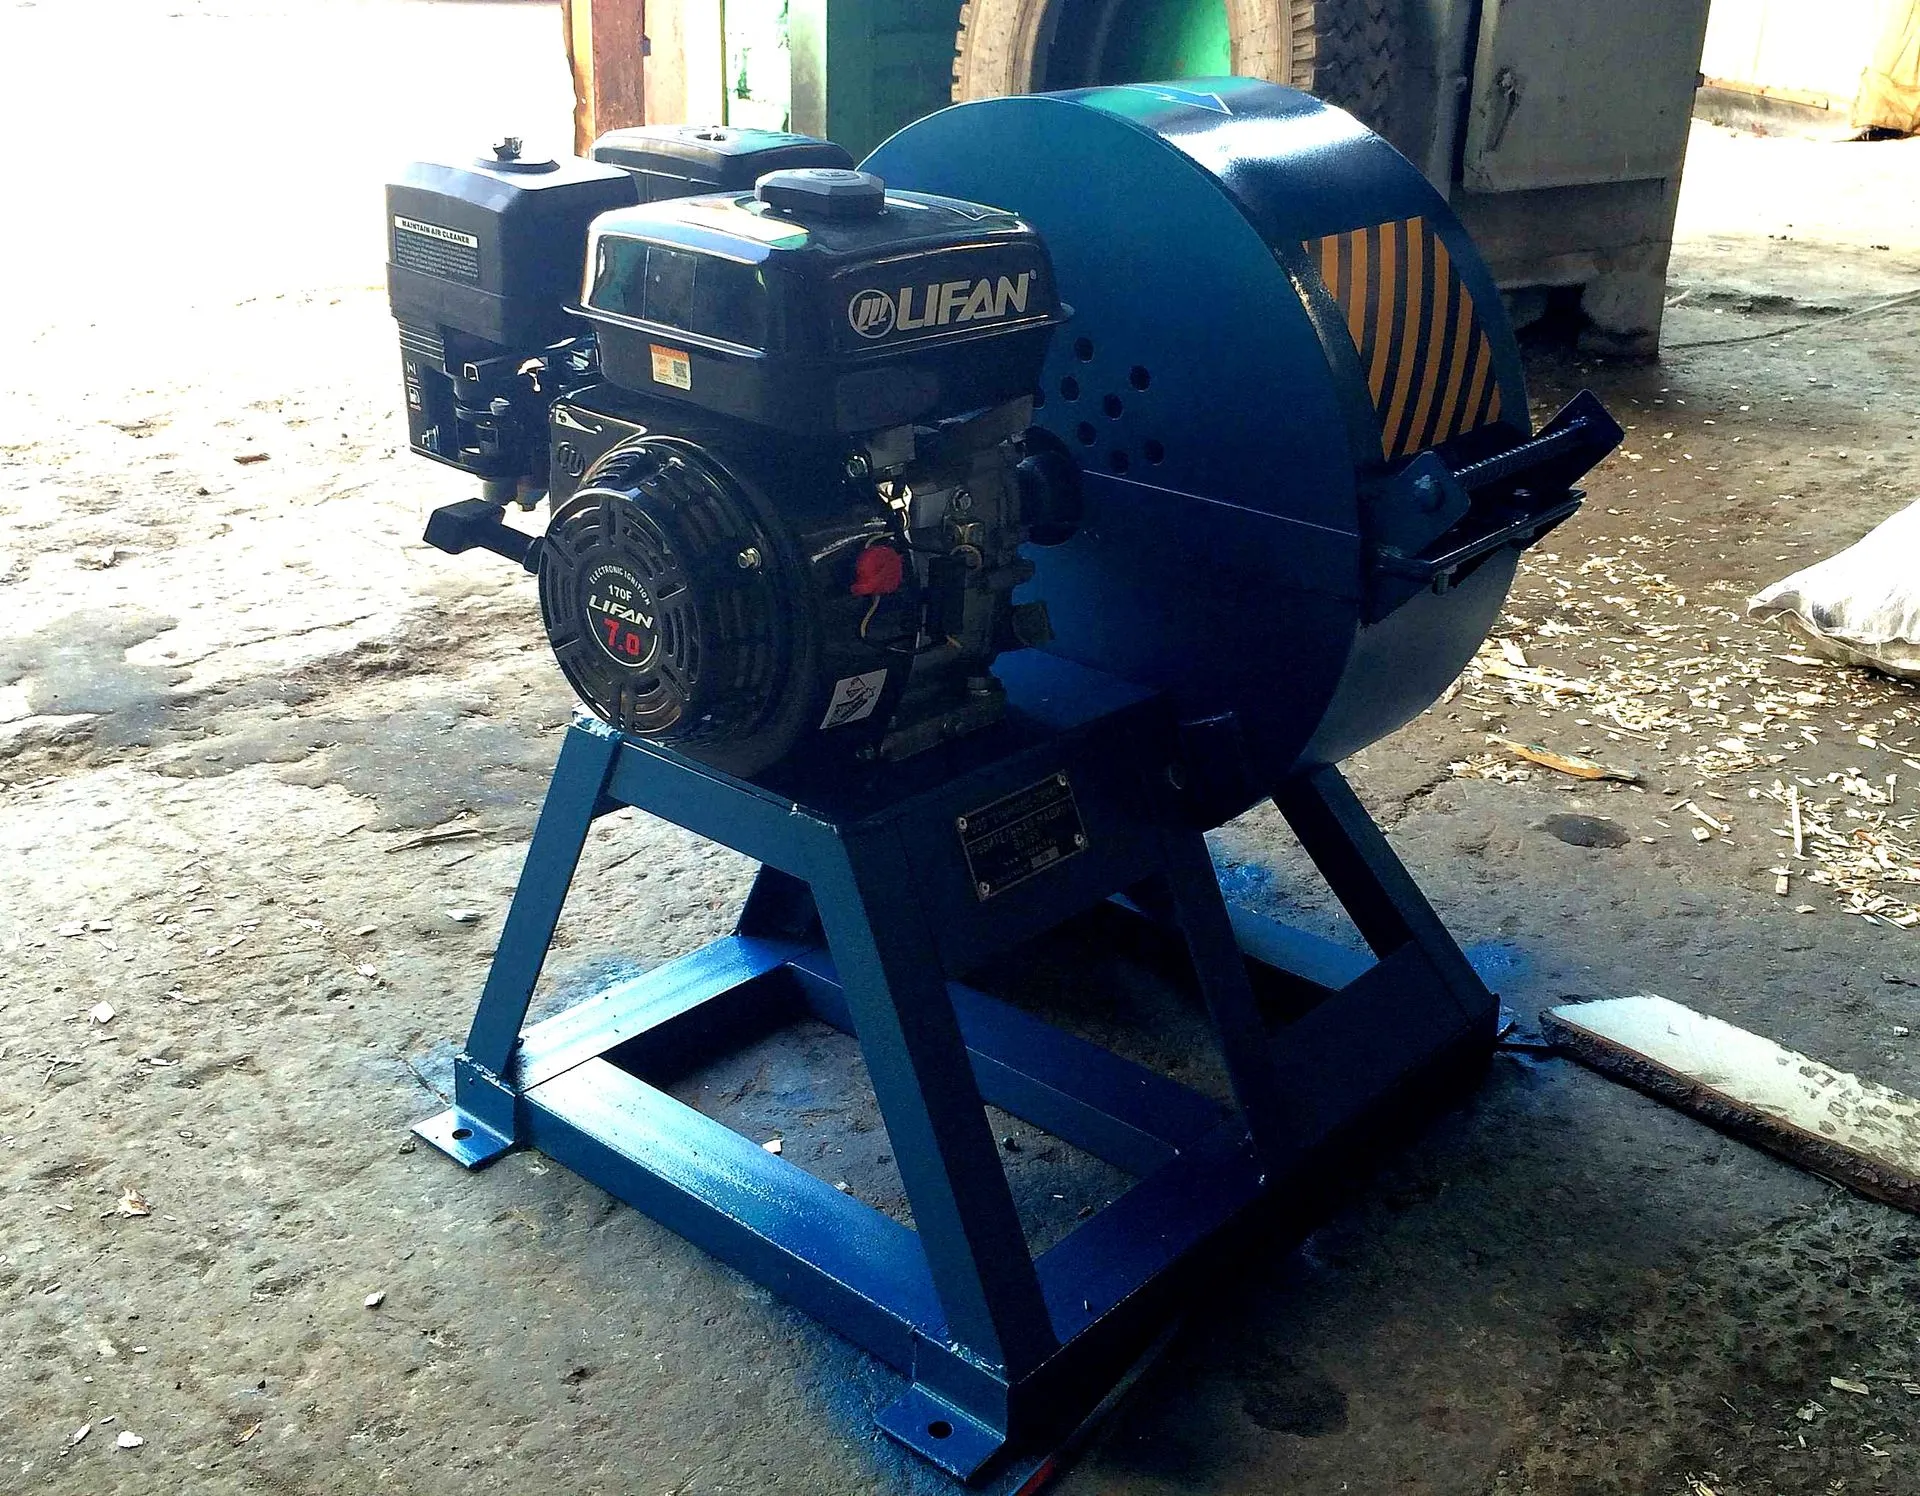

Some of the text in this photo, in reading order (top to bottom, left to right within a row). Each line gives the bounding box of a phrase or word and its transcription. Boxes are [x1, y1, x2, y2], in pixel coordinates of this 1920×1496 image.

[402, 220, 470, 244] MAINTAIN AIR CLEANER
[896, 272, 1030, 331] LIFAN
[589, 565, 651, 606] ELECTRONIC IGNITION
[608, 584, 632, 601] 170F
[588, 595, 654, 629] LIFAN
[603, 618, 640, 655] 7.0
